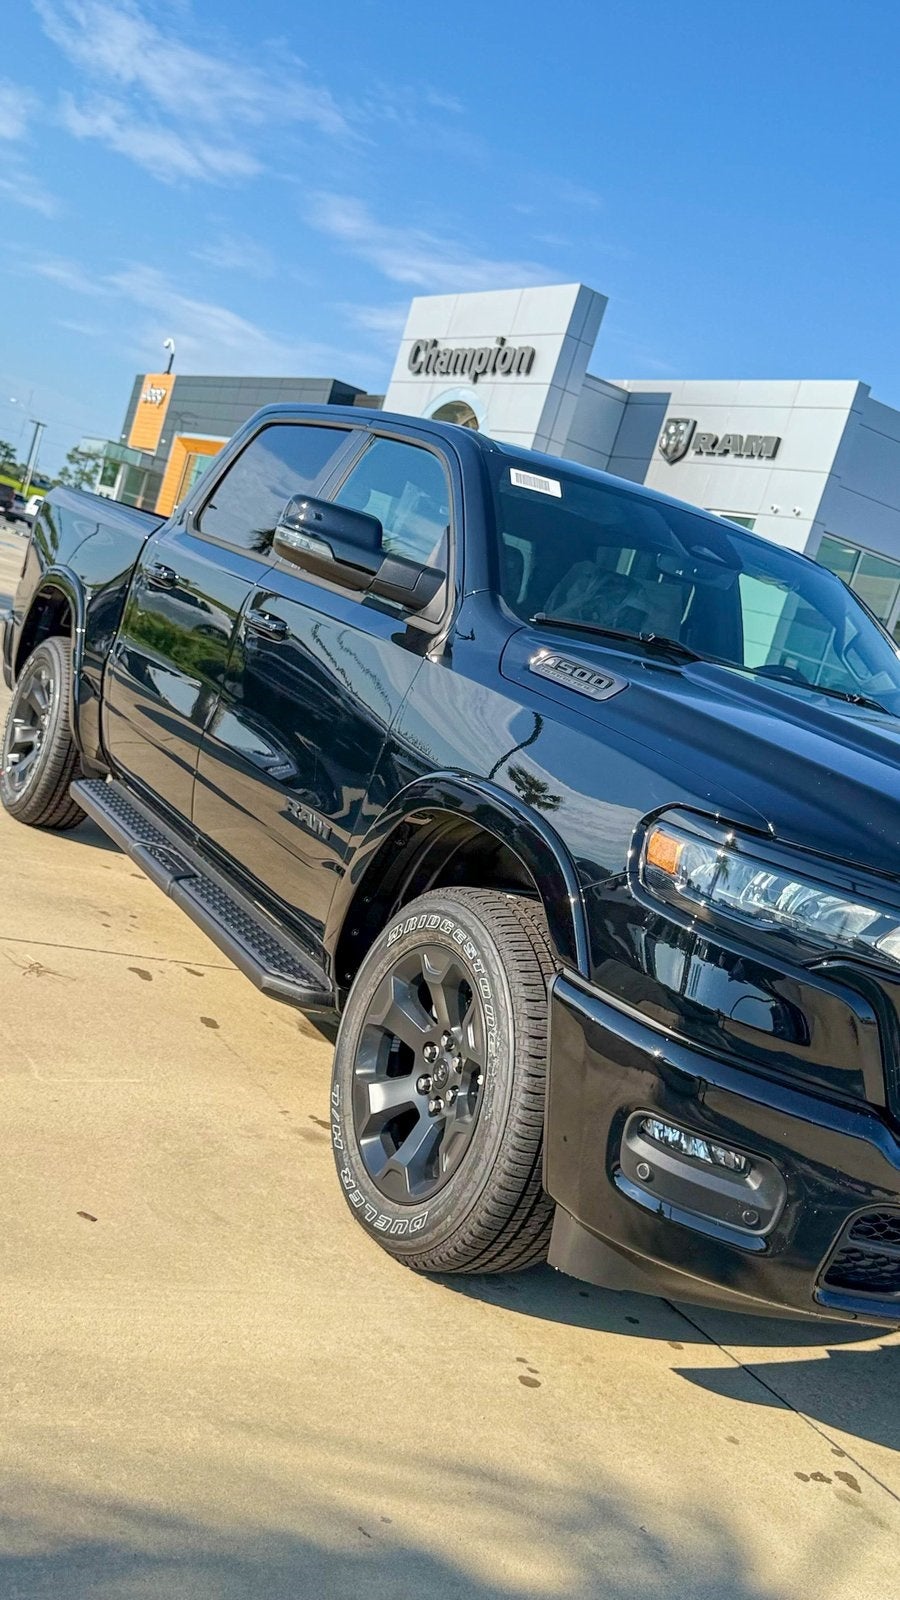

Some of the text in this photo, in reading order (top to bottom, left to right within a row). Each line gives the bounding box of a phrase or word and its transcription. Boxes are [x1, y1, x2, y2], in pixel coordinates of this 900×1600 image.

[408, 336, 536, 384] Champion
[691, 432, 782, 461] RAM
[543, 657, 616, 690] 1500
[286, 796, 333, 841] RAM
[386, 914, 500, 1055] BRIDGESTONE
[340, 1166, 429, 1235] DUELER
